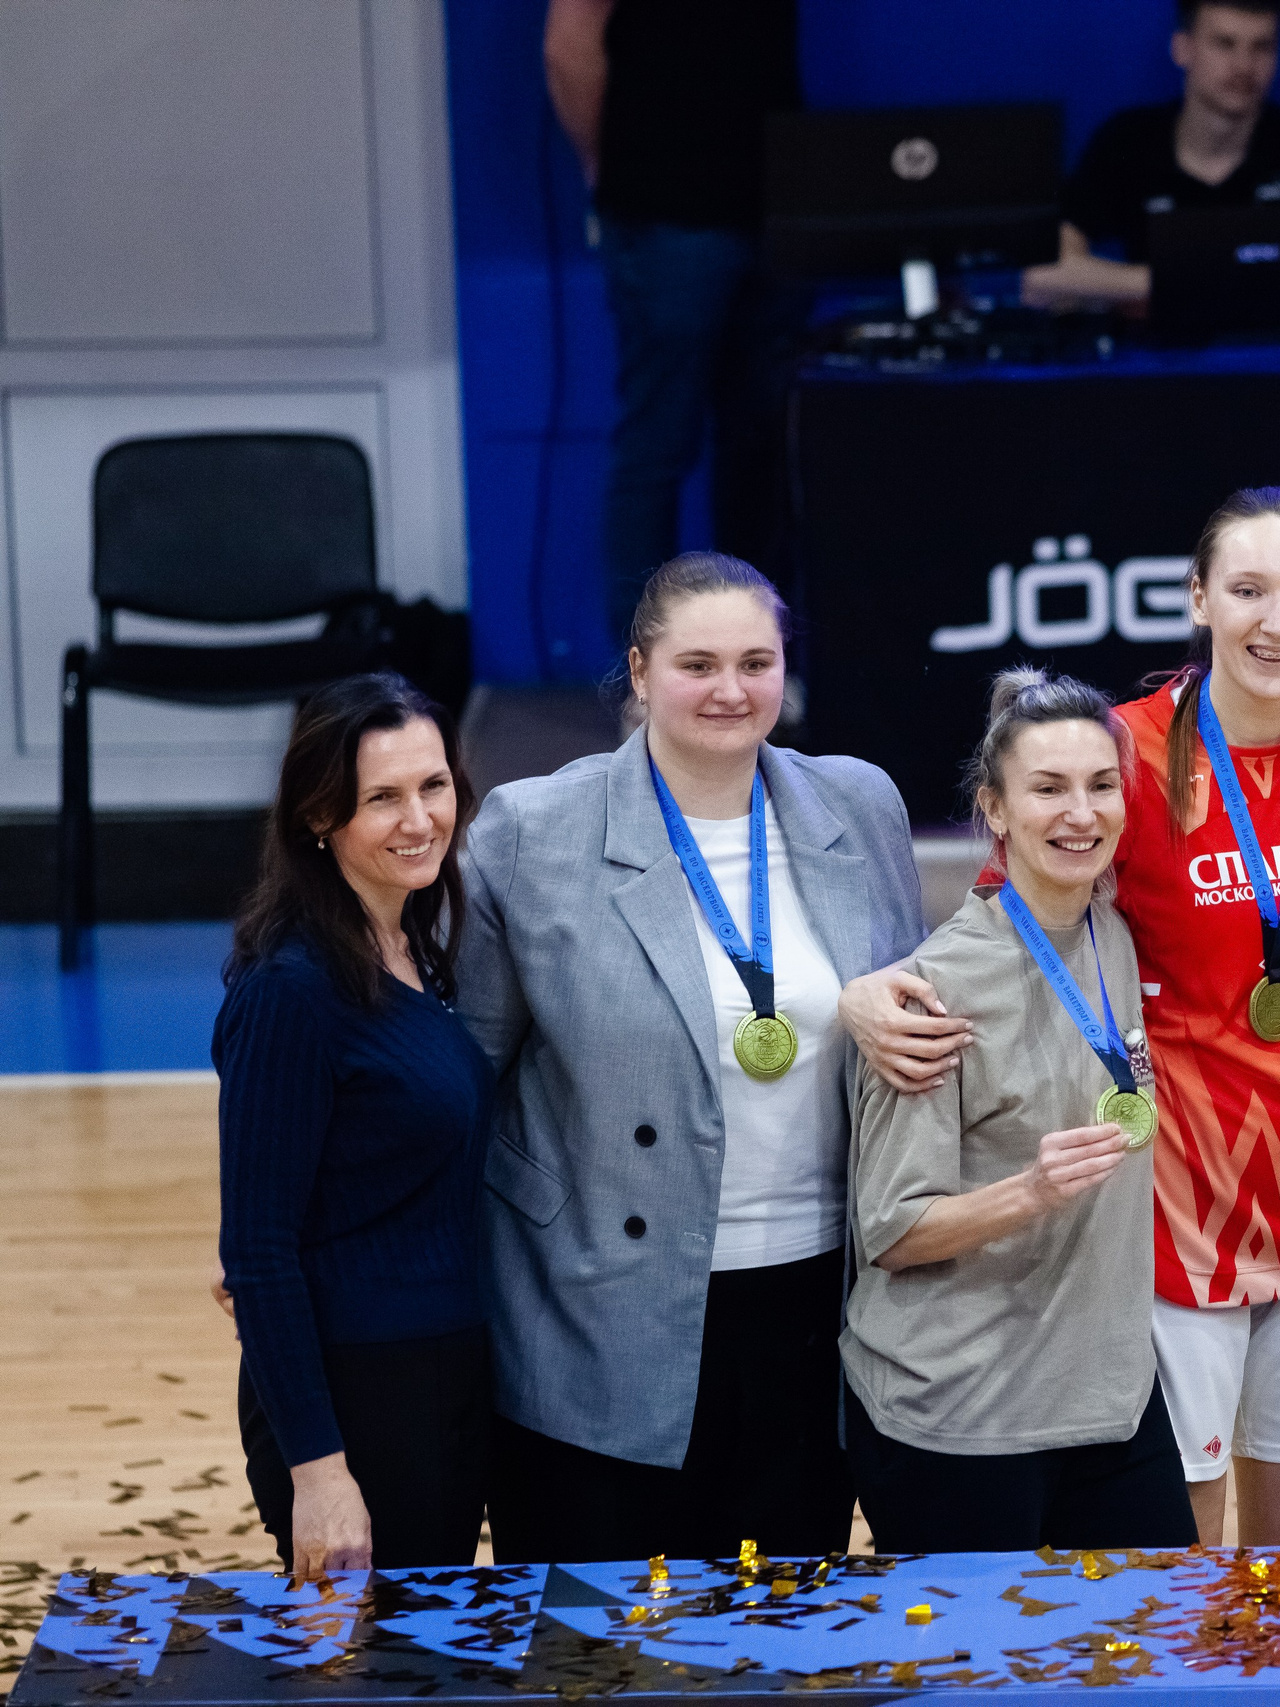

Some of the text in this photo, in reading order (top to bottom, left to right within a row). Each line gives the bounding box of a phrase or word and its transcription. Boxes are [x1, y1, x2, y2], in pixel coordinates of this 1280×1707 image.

[1209, 728, 1229, 774] ЧЕМПИОНАТ
[1224, 778, 1241, 809] РОССИИ
[1236, 812, 1245, 824] ПО
[1241, 828, 1263, 879] БАСКЕТБОЛУ
[674, 824, 692, 853] РОССИИ
[689, 856, 699, 868] ПО
[696, 870, 725, 919] БАСКЕТБОЛУ
[756, 867, 764, 897] FONBET
[756, 901, 765, 924] XXXIV
